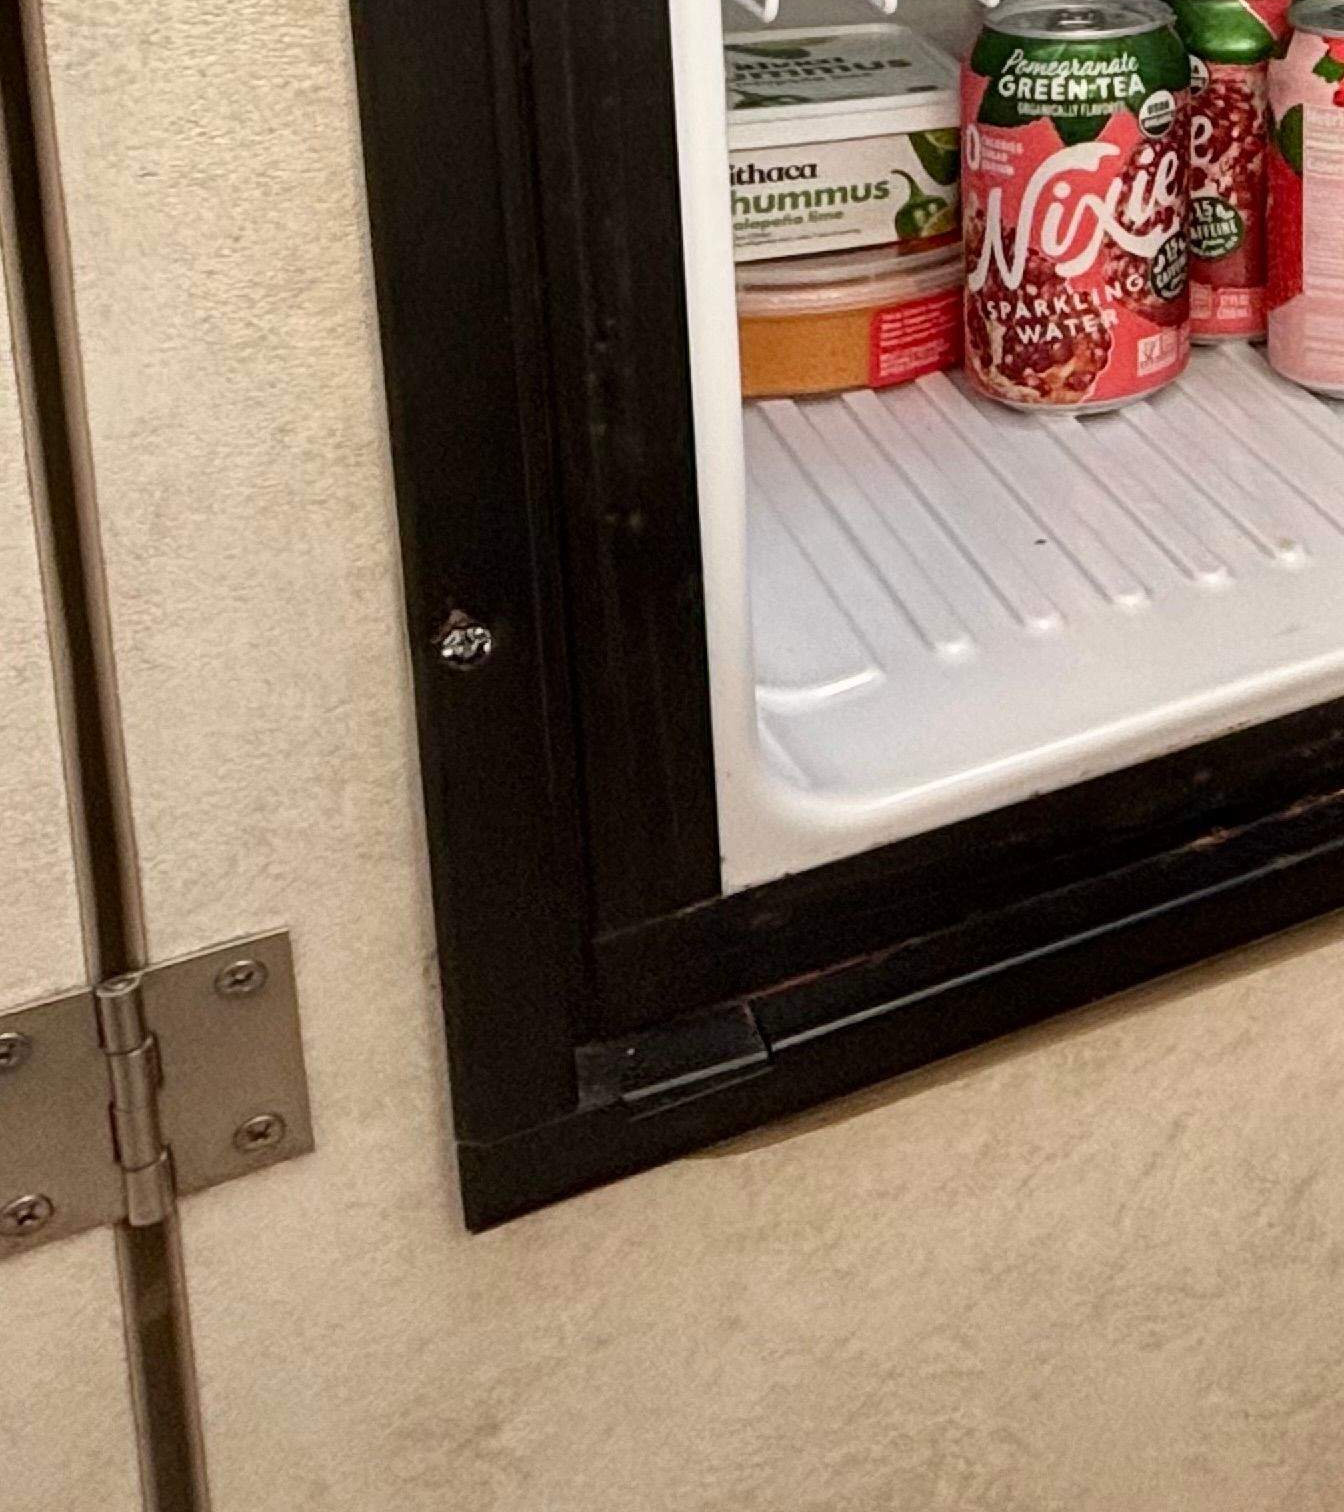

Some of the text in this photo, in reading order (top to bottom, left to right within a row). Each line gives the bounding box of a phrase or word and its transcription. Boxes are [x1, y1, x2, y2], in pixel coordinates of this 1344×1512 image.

[1001, 48, 1139, 78] Pomegranate
[998, 73, 1147, 101] GREEN TEA
[729, 161, 818, 186] ithaca
[731, 178, 891, 216] hummus
[732, 212, 804, 232] alapeño
[968, 142, 1181, 290] Nixie
[986, 273, 1144, 320] SPARKLING
[1017, 308, 1120, 346] WATER
